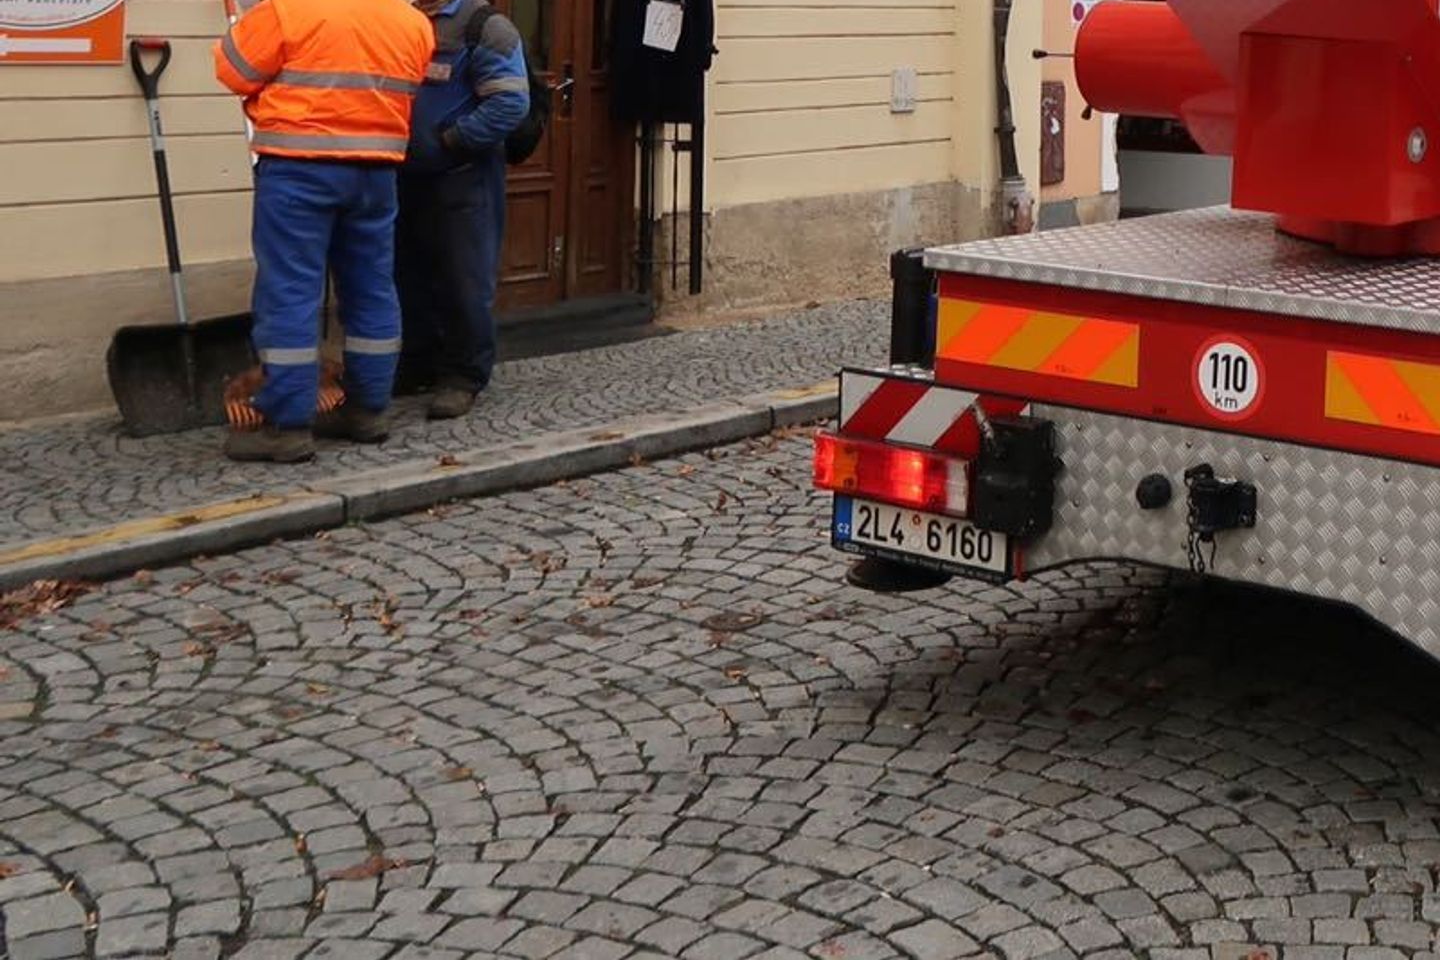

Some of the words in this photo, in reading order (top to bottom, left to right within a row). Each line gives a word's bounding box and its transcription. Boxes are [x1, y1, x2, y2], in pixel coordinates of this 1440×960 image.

[1209, 352, 1247, 393] 110
[1215, 392, 1238, 408] km
[837, 521, 850, 535] CZ
[857, 505, 905, 546] 2L4
[926, 519, 993, 563] 6160
